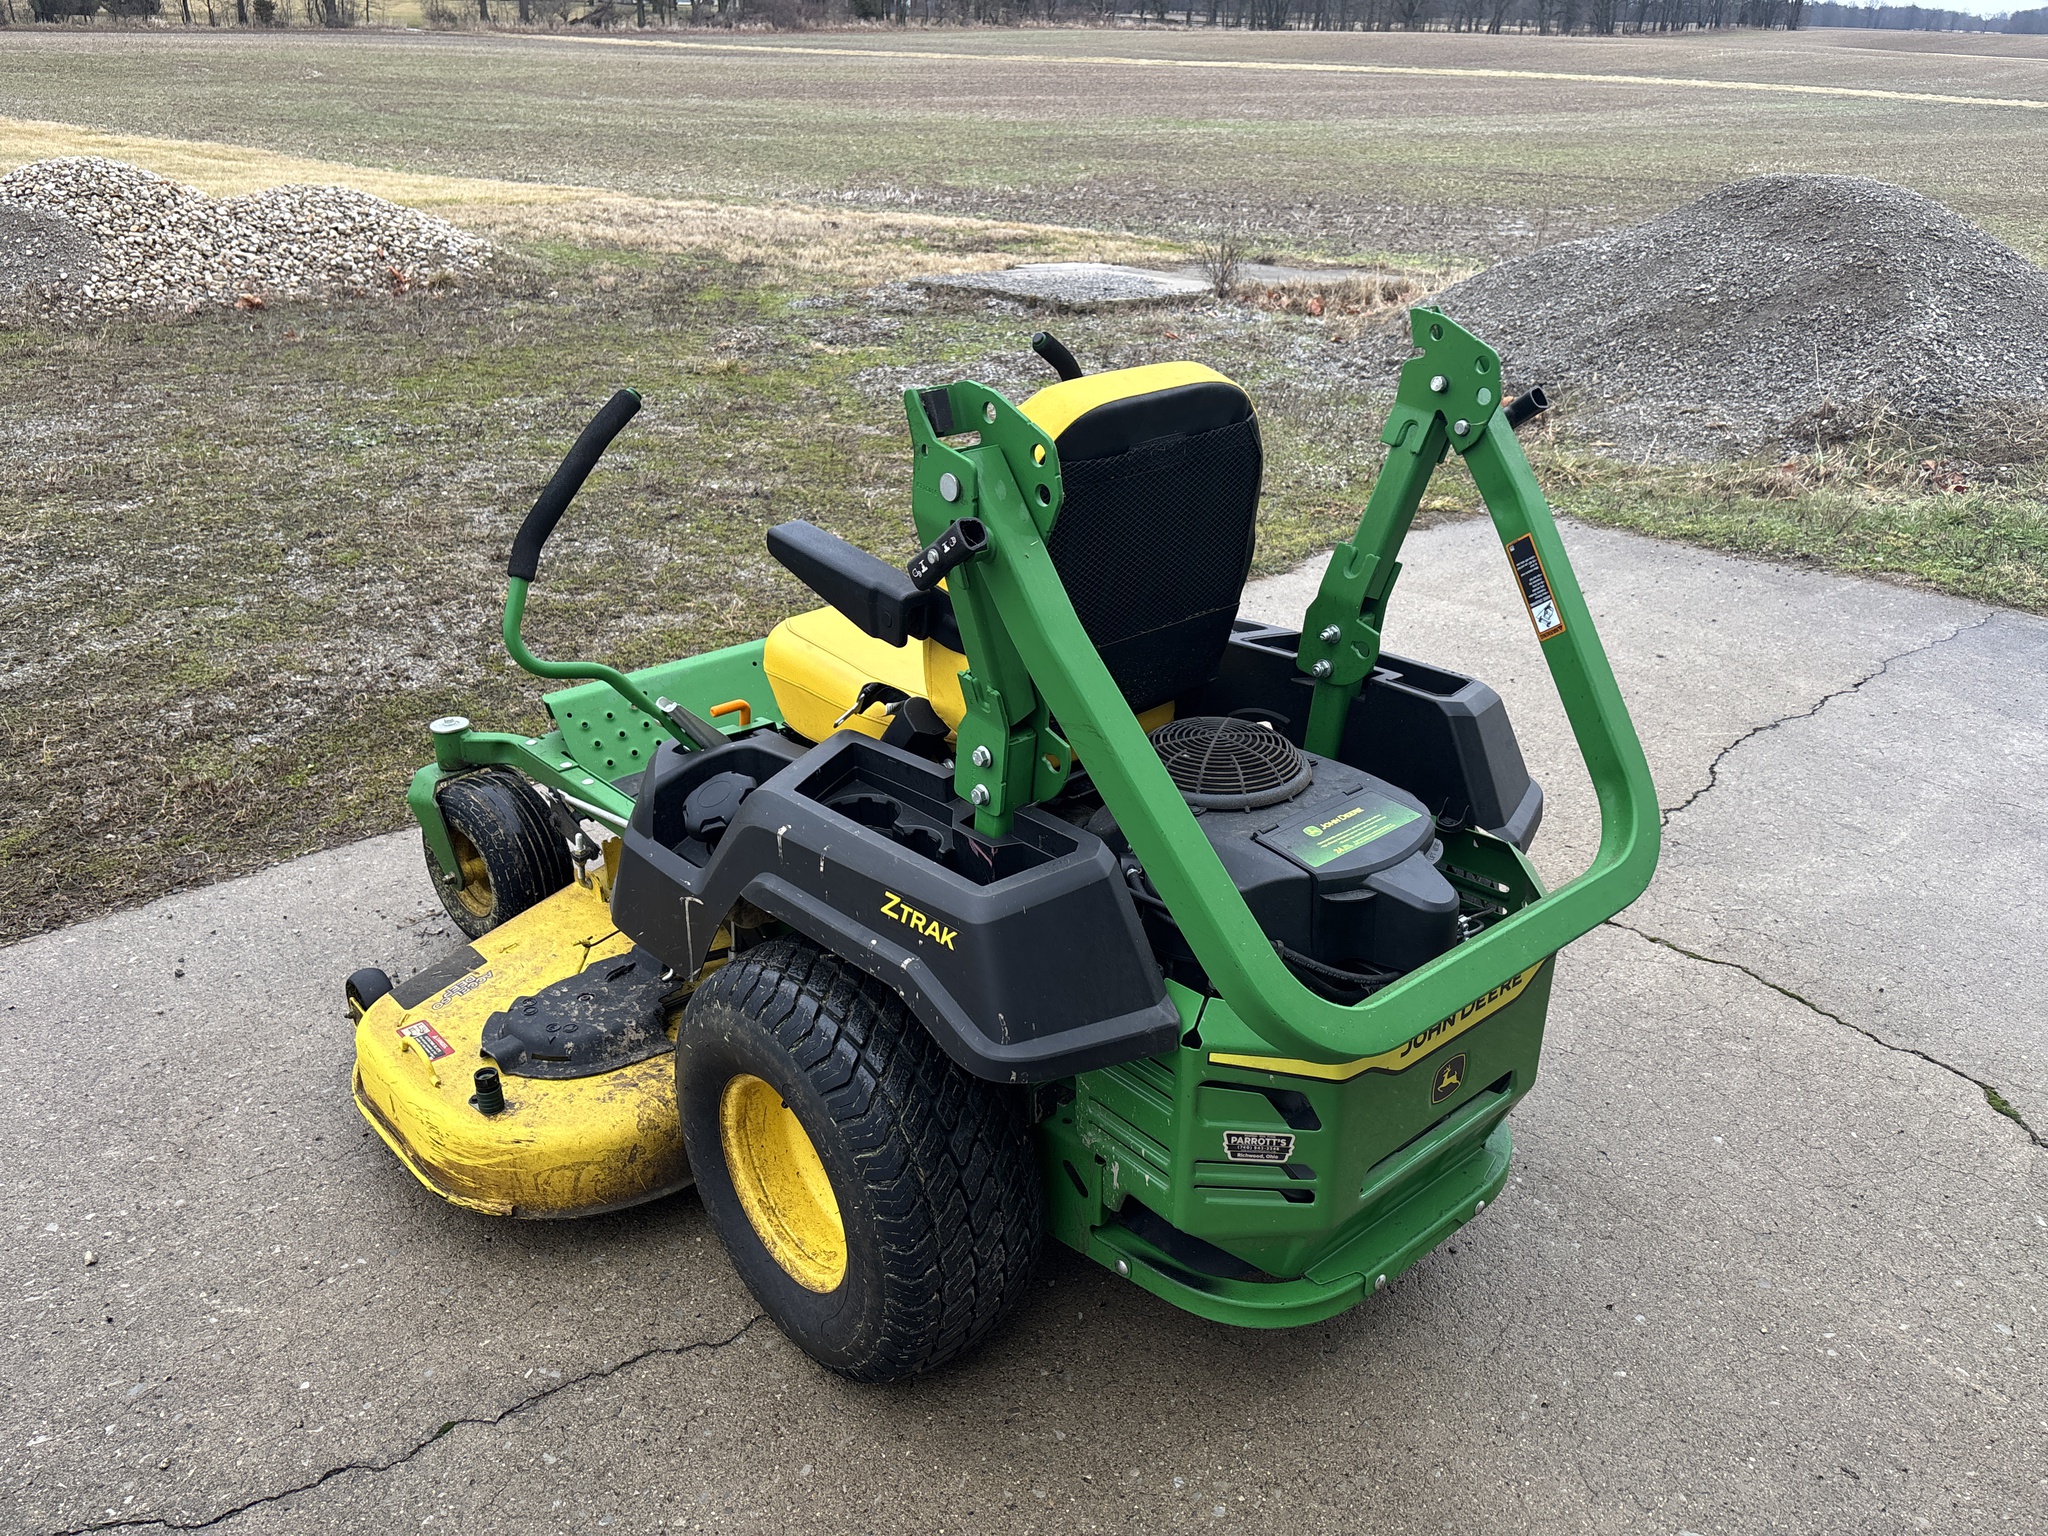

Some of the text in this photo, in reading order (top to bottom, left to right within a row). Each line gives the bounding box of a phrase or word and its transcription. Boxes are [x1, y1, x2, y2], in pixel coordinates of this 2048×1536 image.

[880, 891, 958, 951] ZTRAK
[1400, 974, 1523, 1058] JOHN DEERE
[1231, 1136, 1287, 1146] PARROTT'S
